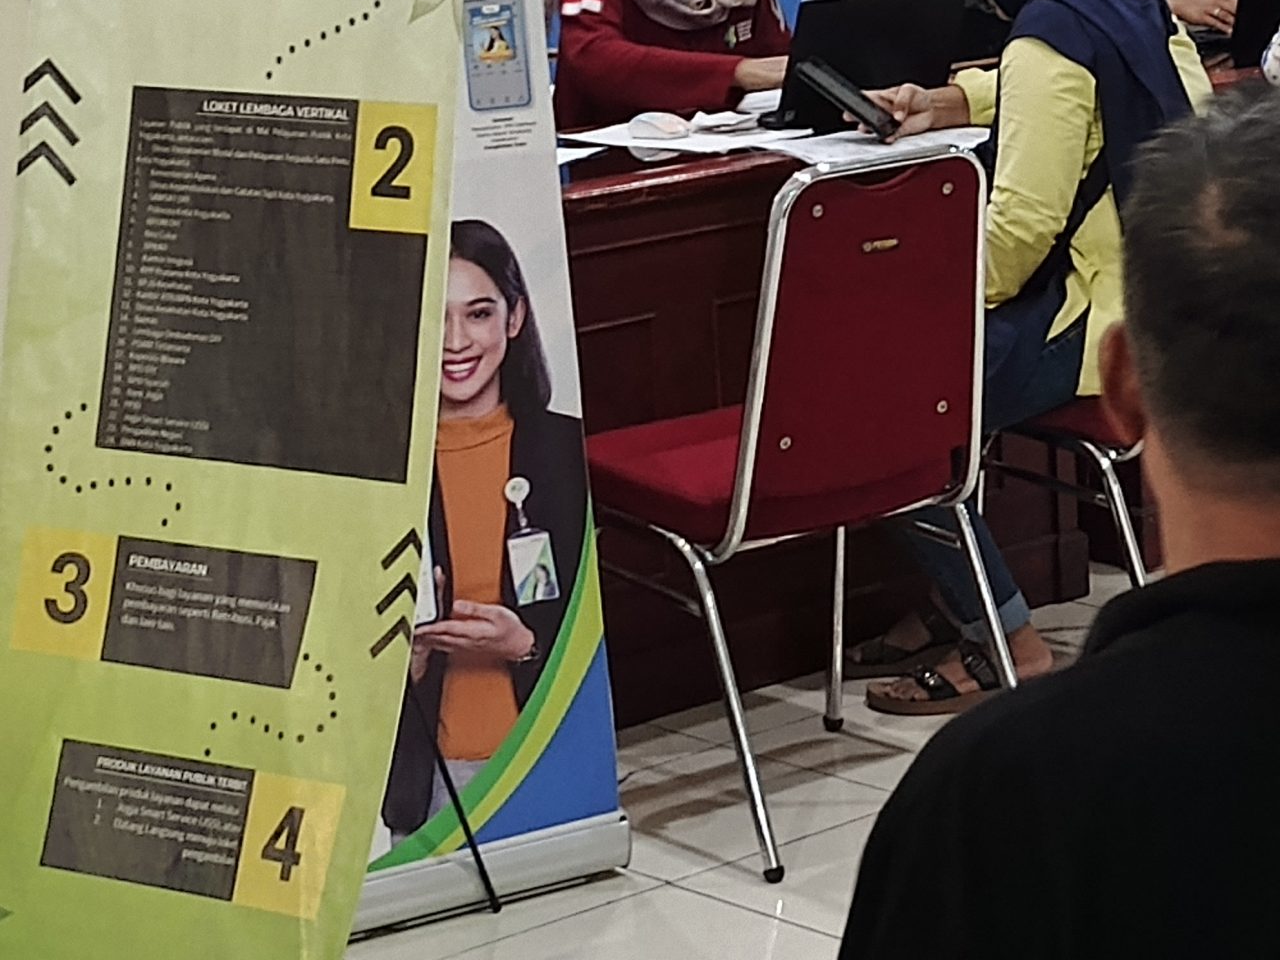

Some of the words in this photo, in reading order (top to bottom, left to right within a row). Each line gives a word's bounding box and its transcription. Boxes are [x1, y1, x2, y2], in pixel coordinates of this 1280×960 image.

[203, 99, 238, 114] LOKET
[239, 102, 294, 118] LEMBAGA
[296, 106, 349, 121] VERTIKAL
[371, 125, 414, 200] 2
[44, 552, 91, 624] 3
[129, 554, 208, 576] PEMBAYARAN
[97, 756, 137, 773] PRODUK
[138, 762, 182, 780] LAYANAN
[183, 770, 217, 786] PUBLIK
[261, 806, 305, 881] 4
